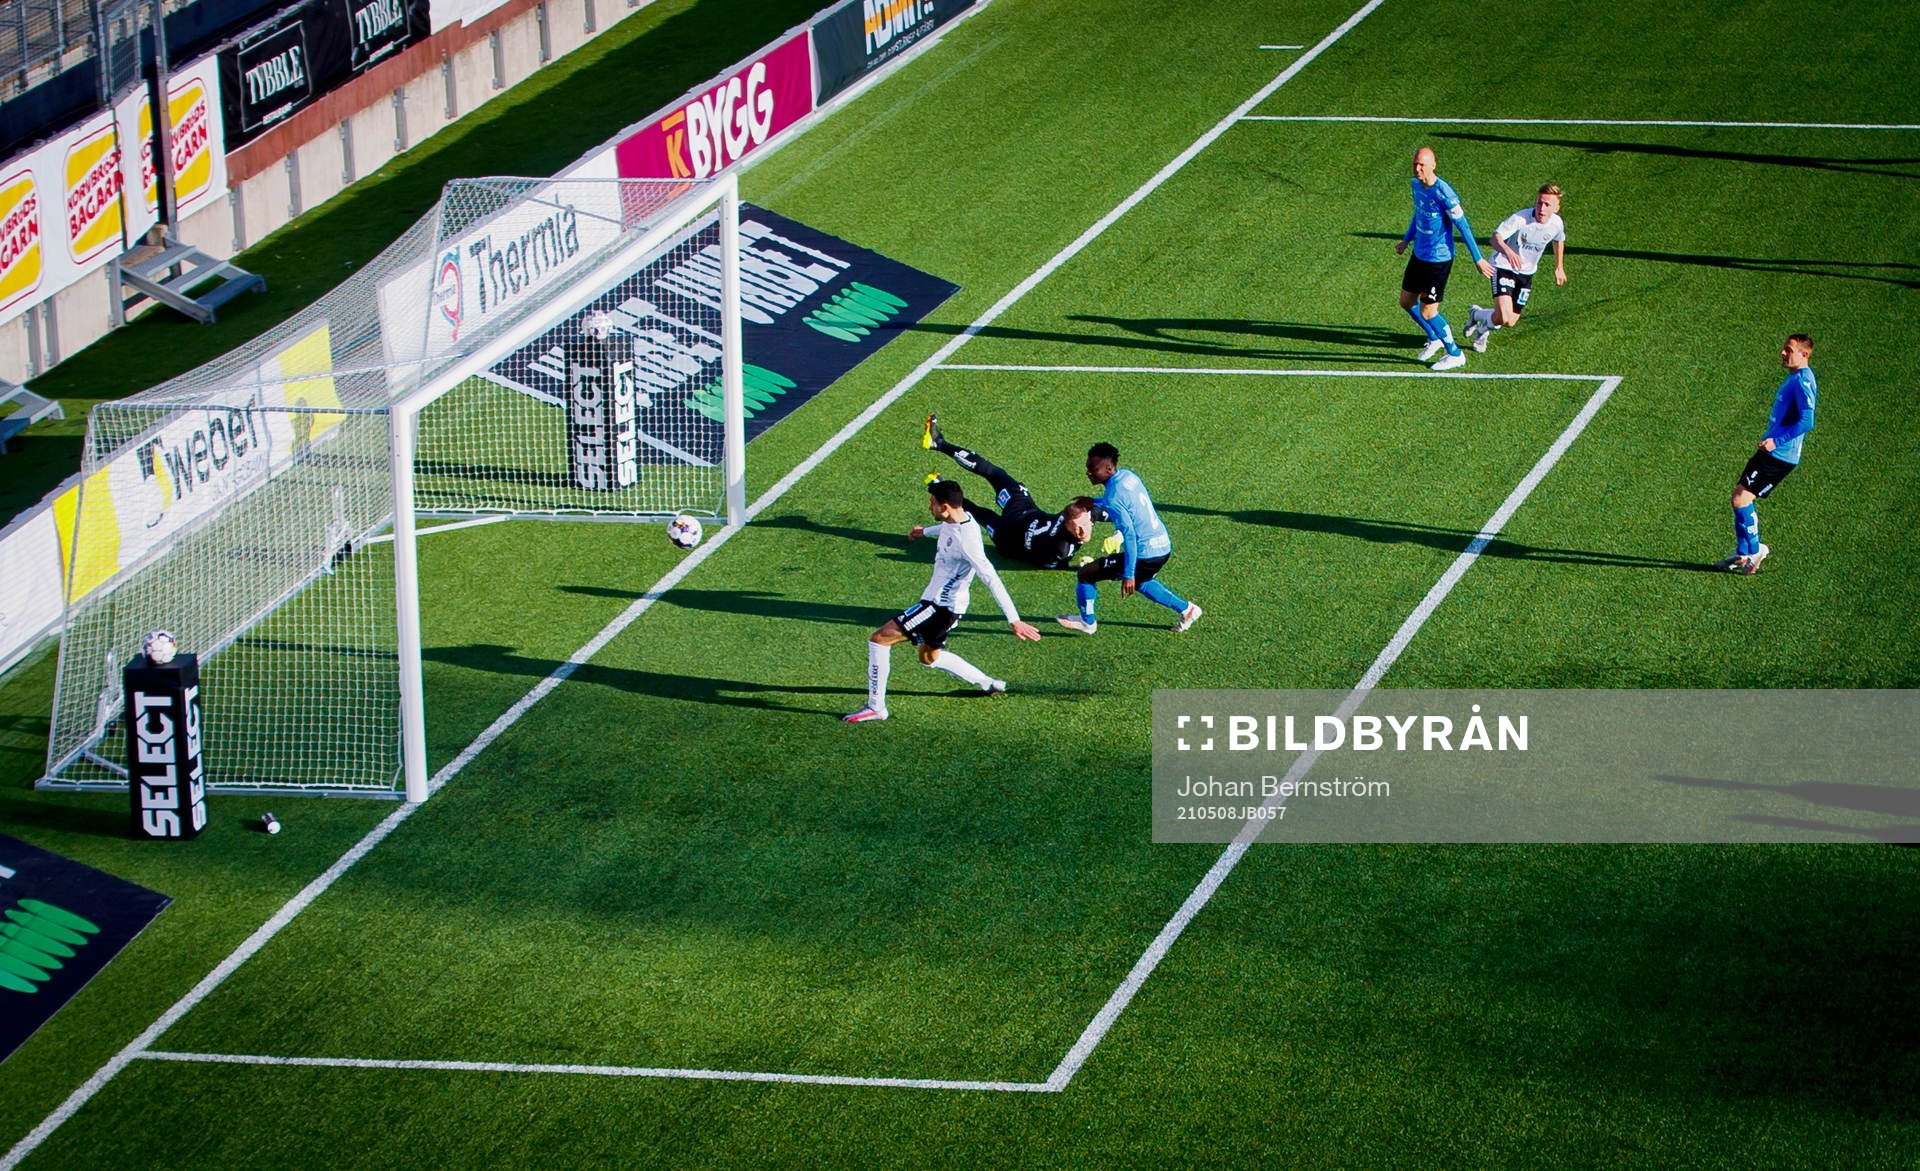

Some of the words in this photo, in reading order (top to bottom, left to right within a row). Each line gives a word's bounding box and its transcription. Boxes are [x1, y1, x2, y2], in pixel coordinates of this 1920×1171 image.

[245, 45, 304, 105] TYBBLE
[0, 213, 38, 274] GARN
[572, 361, 607, 490] SELECT
[613, 360, 638, 487] SELECT
[134, 691, 181, 837] SELECT
[184, 685, 207, 831] SELECT
